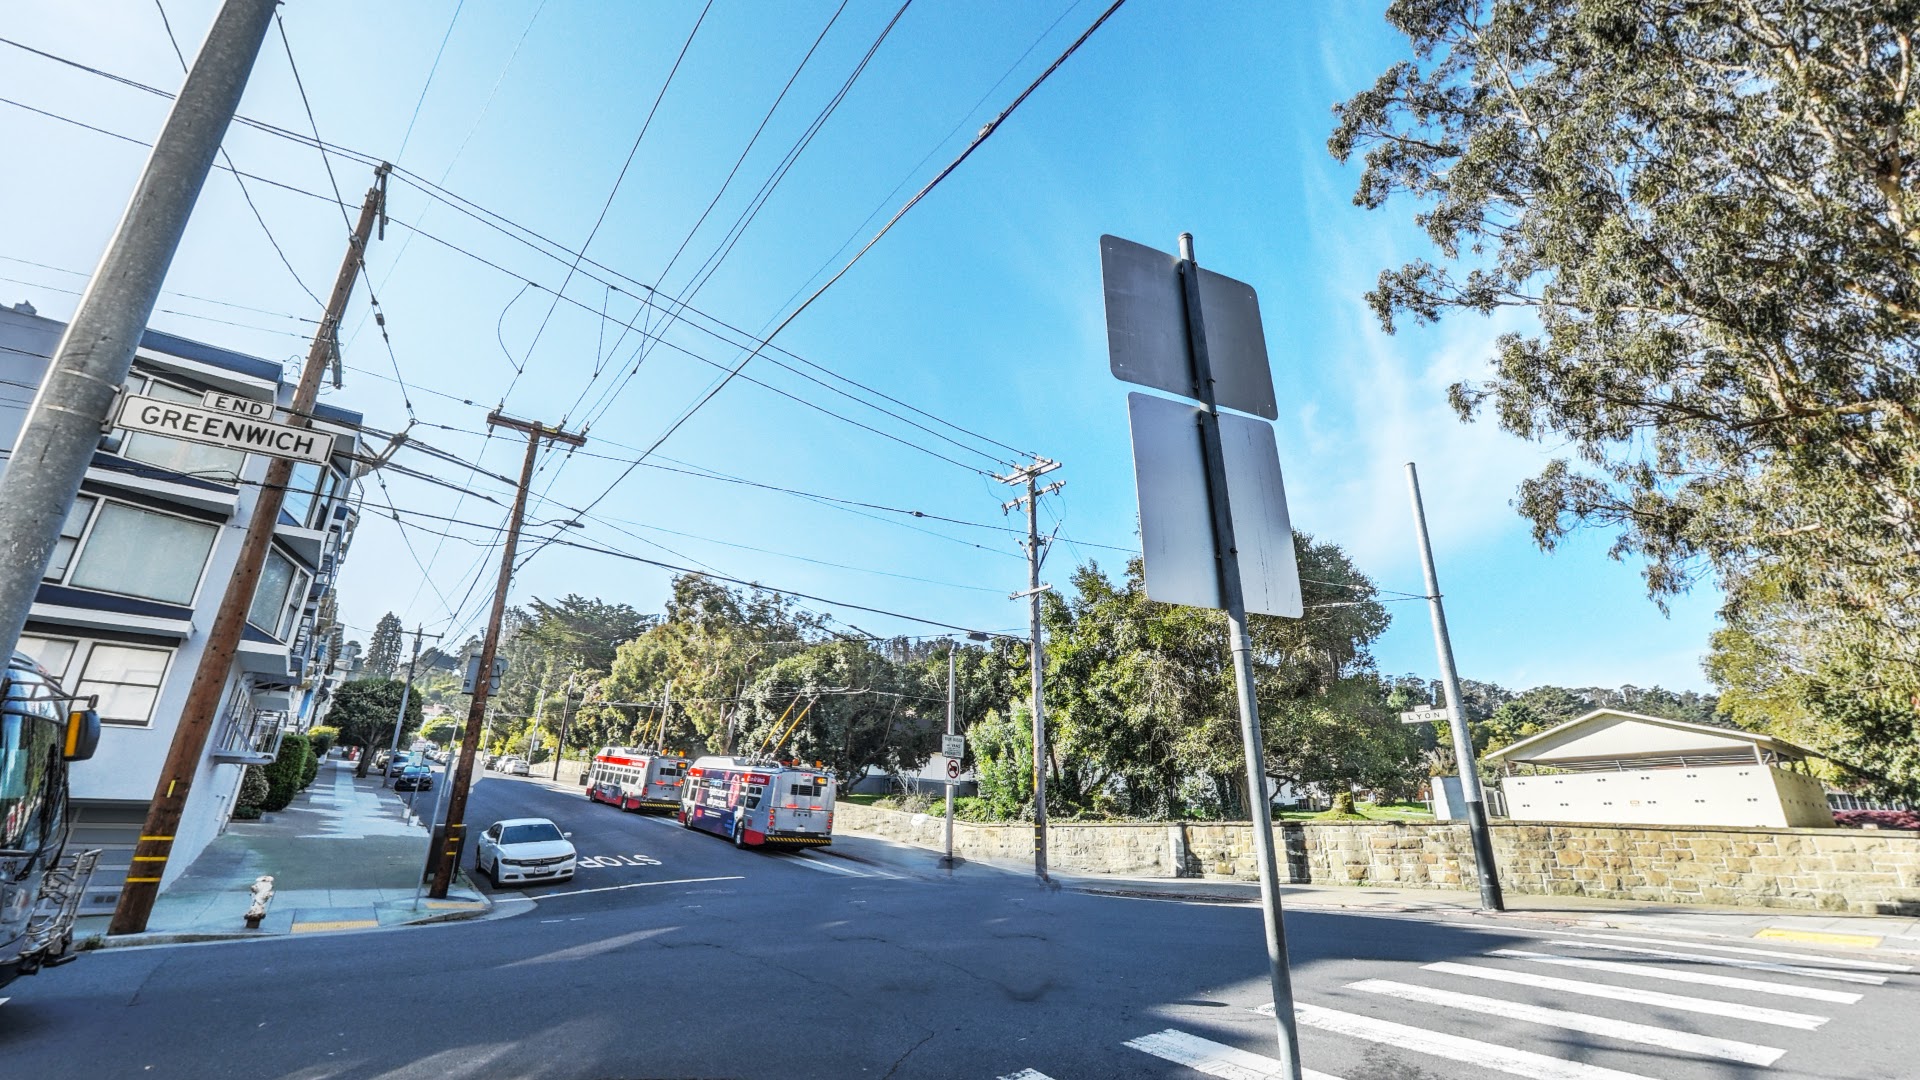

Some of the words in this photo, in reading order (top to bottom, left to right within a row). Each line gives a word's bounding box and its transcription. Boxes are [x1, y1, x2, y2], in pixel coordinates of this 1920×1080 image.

[215, 396, 263, 416] END
[141, 405, 315, 455] GREENWICH
[1408, 712, 1440, 720] LYON
[577, 854, 663, 869] STOP
